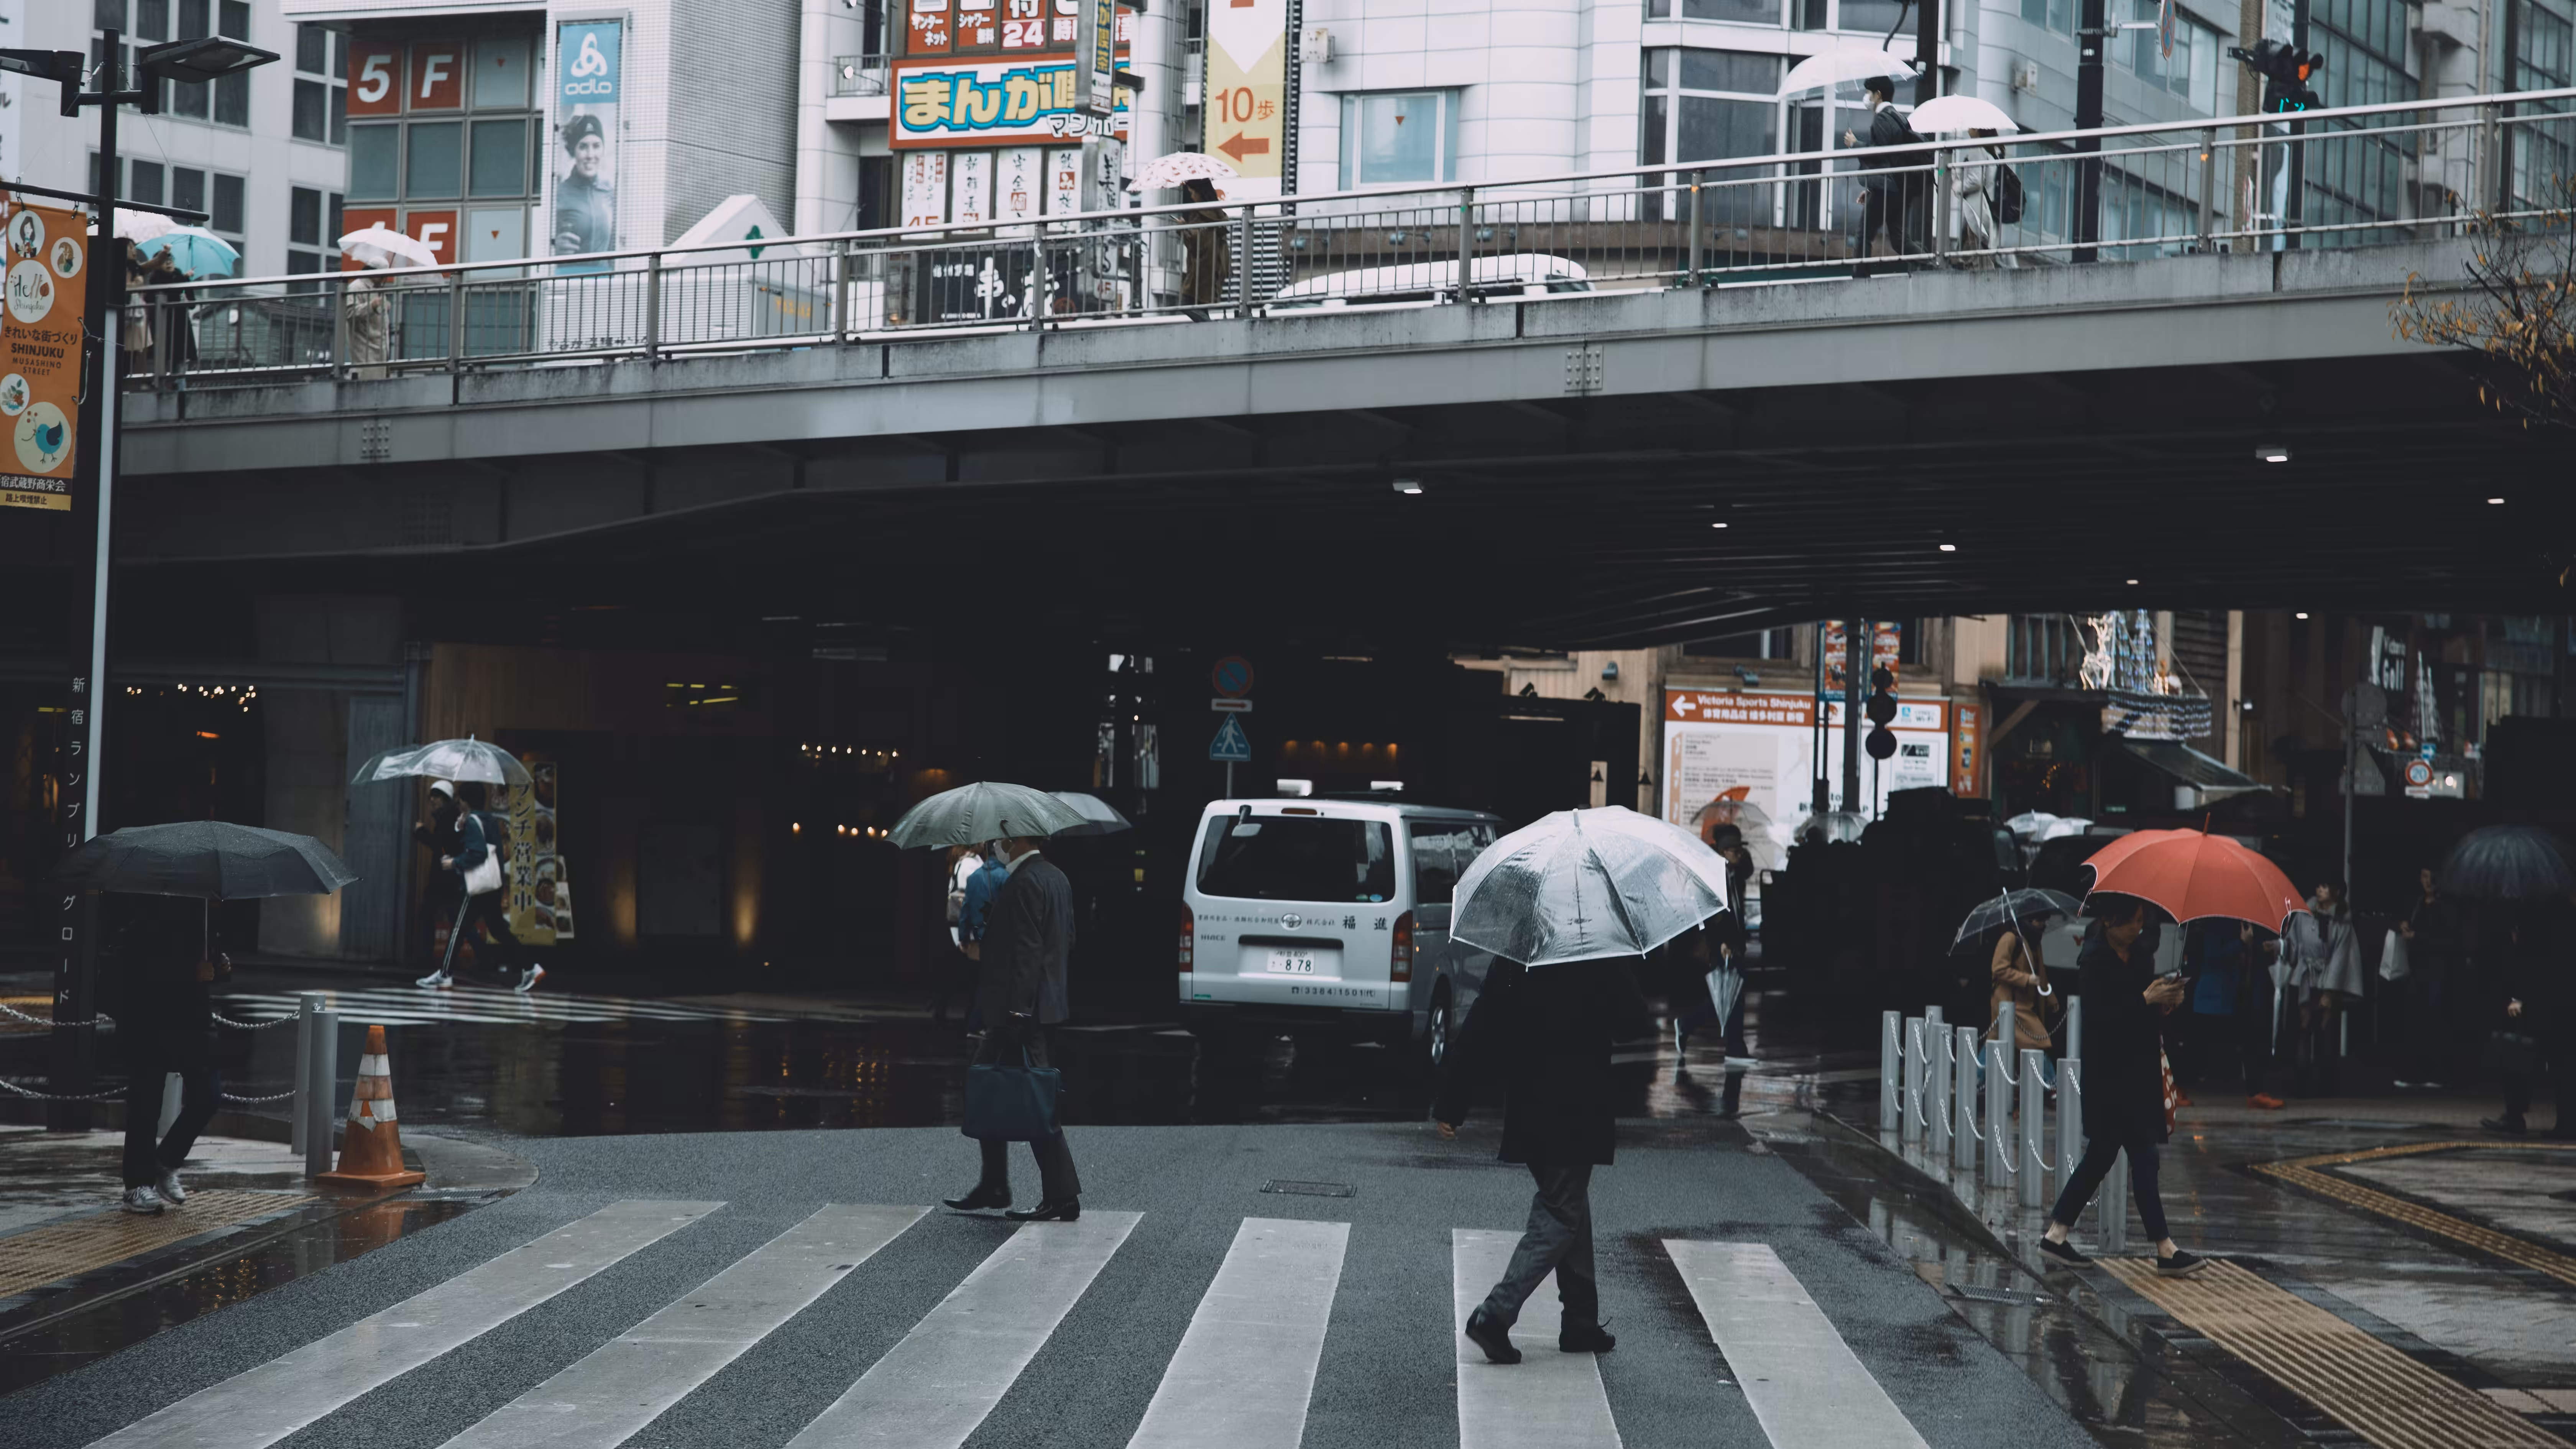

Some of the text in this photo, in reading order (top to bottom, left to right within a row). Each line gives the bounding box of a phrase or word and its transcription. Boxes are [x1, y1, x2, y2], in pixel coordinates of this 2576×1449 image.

[910, 13, 944, 30] インター
[958, 12, 991, 28] シャワー
[924, 30, 947, 46] ネット
[976, 28, 995, 44] 無料
[565, 78, 613, 95] odlo
[4, 326, 77, 345] きれいな街づくり
[11, 342, 64, 358] SHINJUKU
[12, 357, 62, 369] MUSASHINO
[23, 366, 50, 376] STREET
[0, 475, 66, 492] 宿武蔵野商栄会
[1697, 694, 1811, 710] Victoria Sports Shinjuku
[2412, 766, 2428, 780] 20
